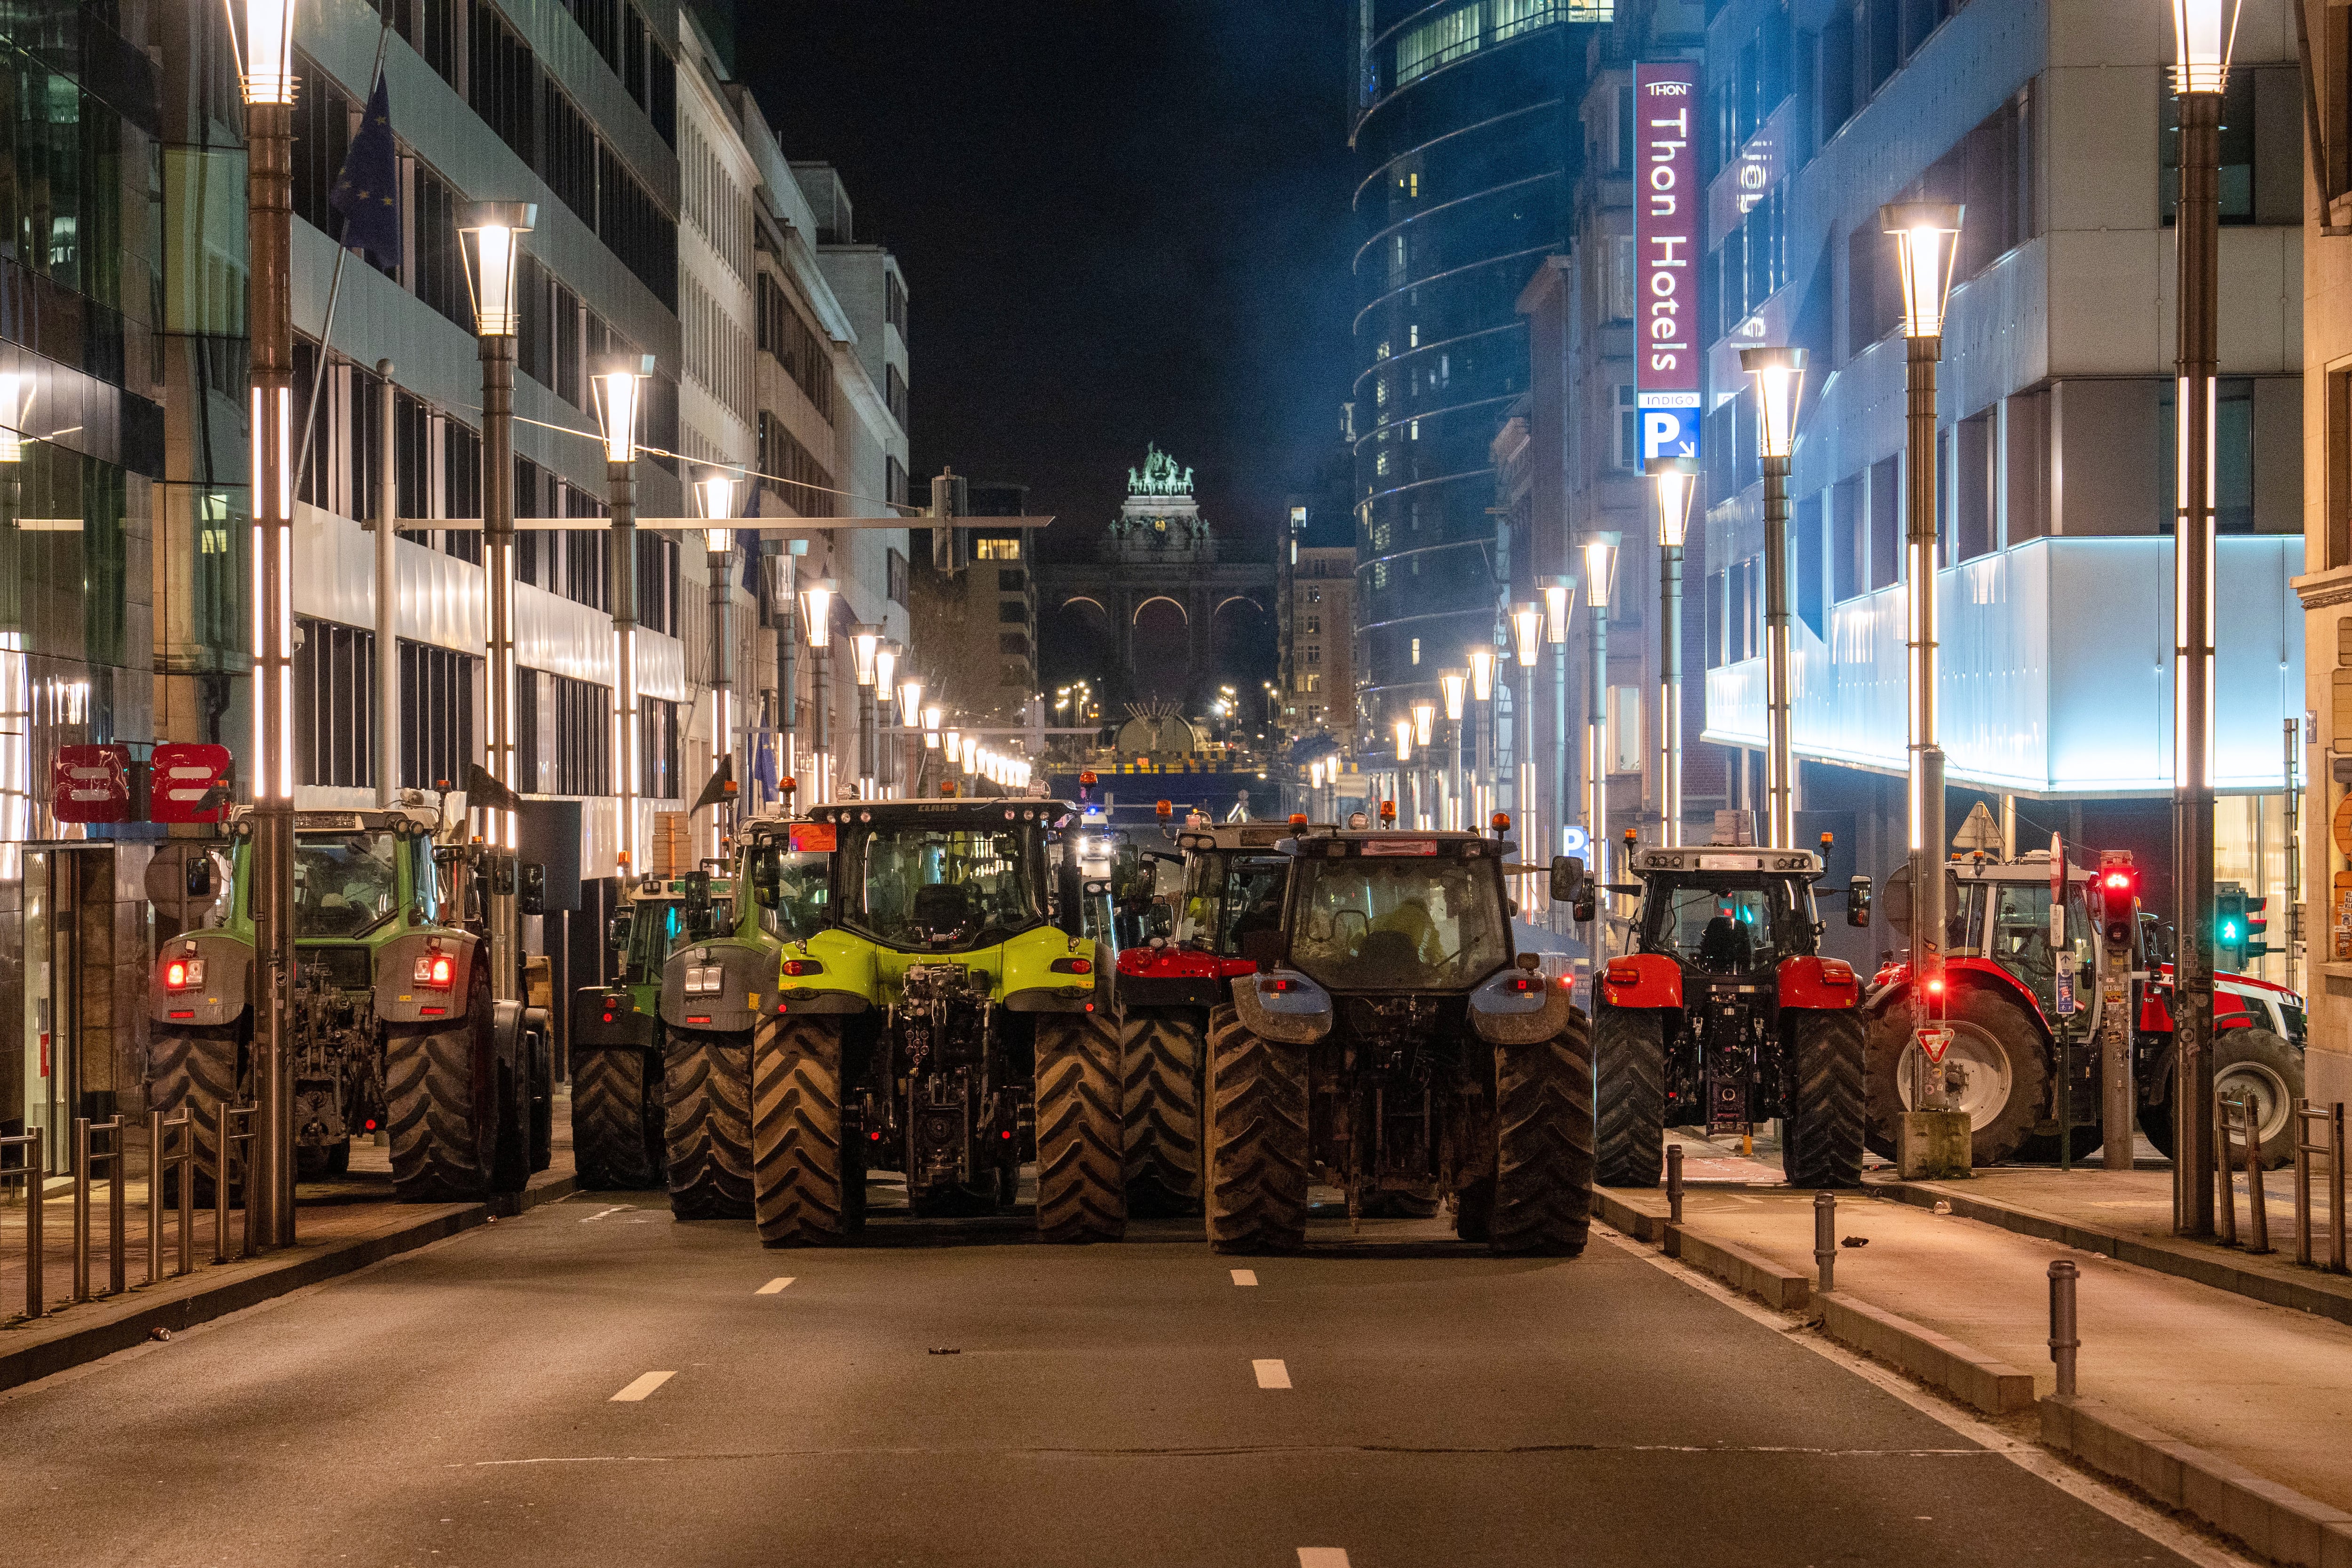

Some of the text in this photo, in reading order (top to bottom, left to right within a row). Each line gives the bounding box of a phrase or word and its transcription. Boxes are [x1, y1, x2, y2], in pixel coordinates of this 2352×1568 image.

[1645, 81, 1692, 96] THON
[1651, 108, 1687, 371] Thon Hotels
[1645, 412, 1680, 458] P
[1563, 828, 1584, 856] P
